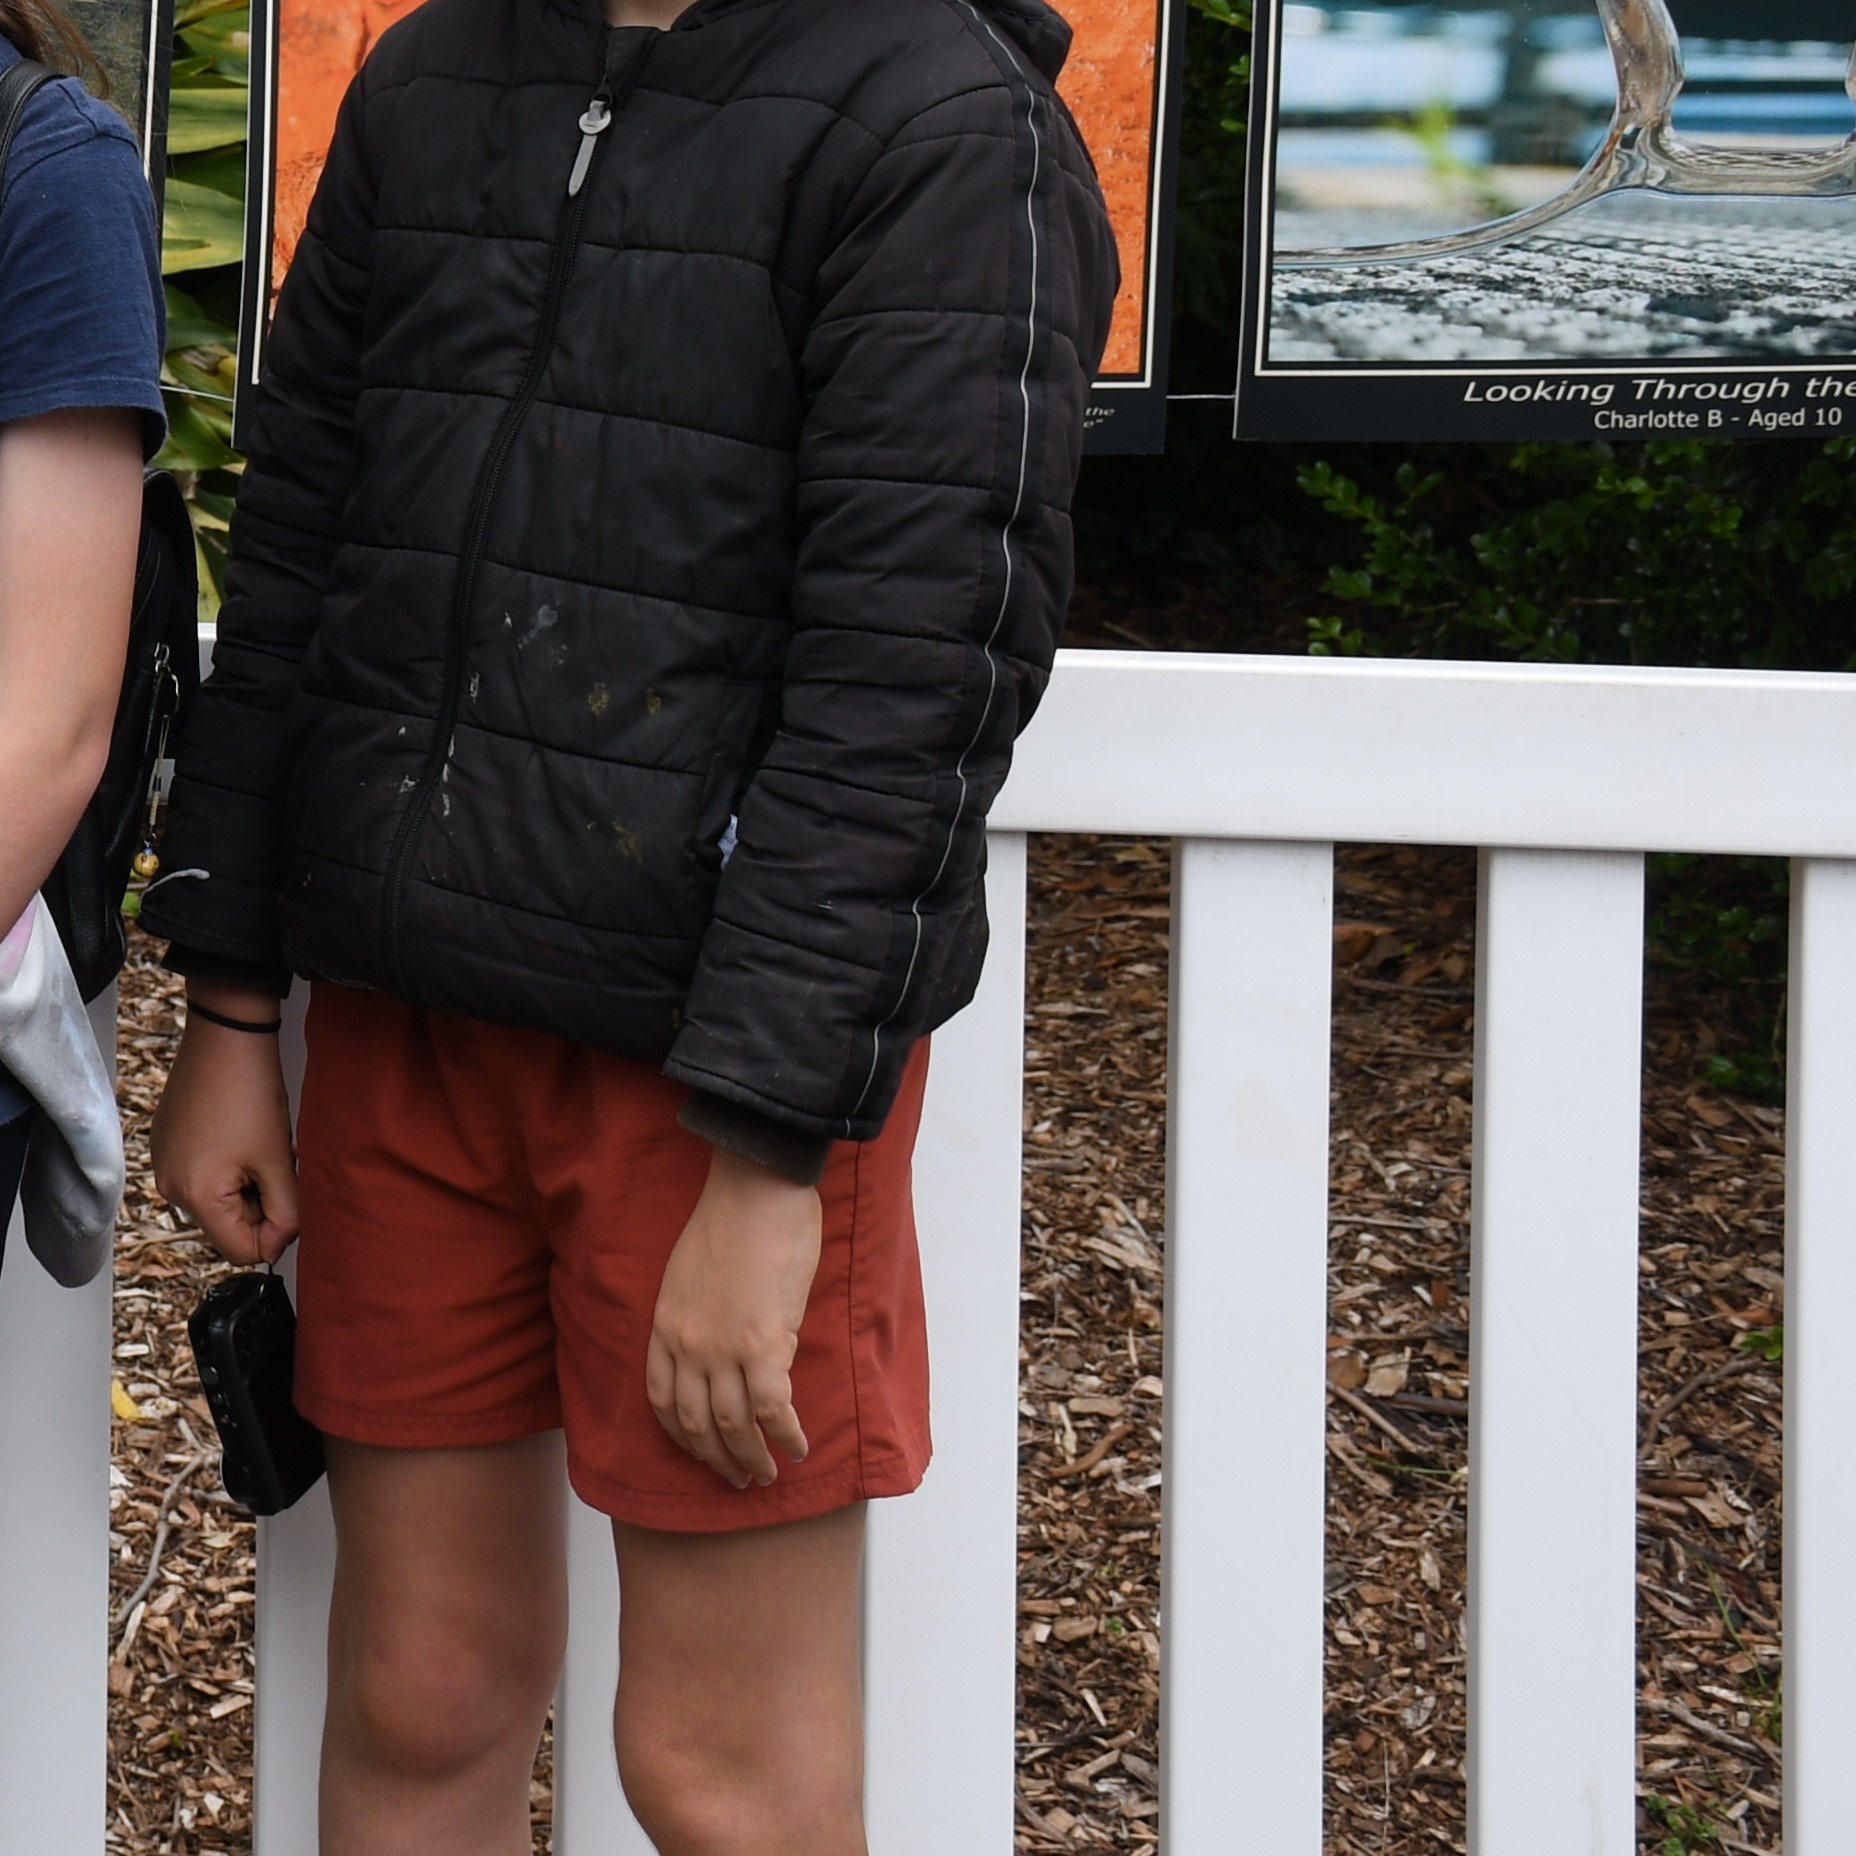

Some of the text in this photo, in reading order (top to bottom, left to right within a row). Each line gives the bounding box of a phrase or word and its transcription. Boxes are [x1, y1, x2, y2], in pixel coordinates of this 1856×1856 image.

[1463, 379, 1615, 406] Looking
[1632, 377, 1790, 404] Through
[1594, 409, 1700, 429] Charlotte
[1707, 409, 1723, 428] B
[1748, 407, 1806, 431] Aged
[1815, 407, 1842, 426] 10
